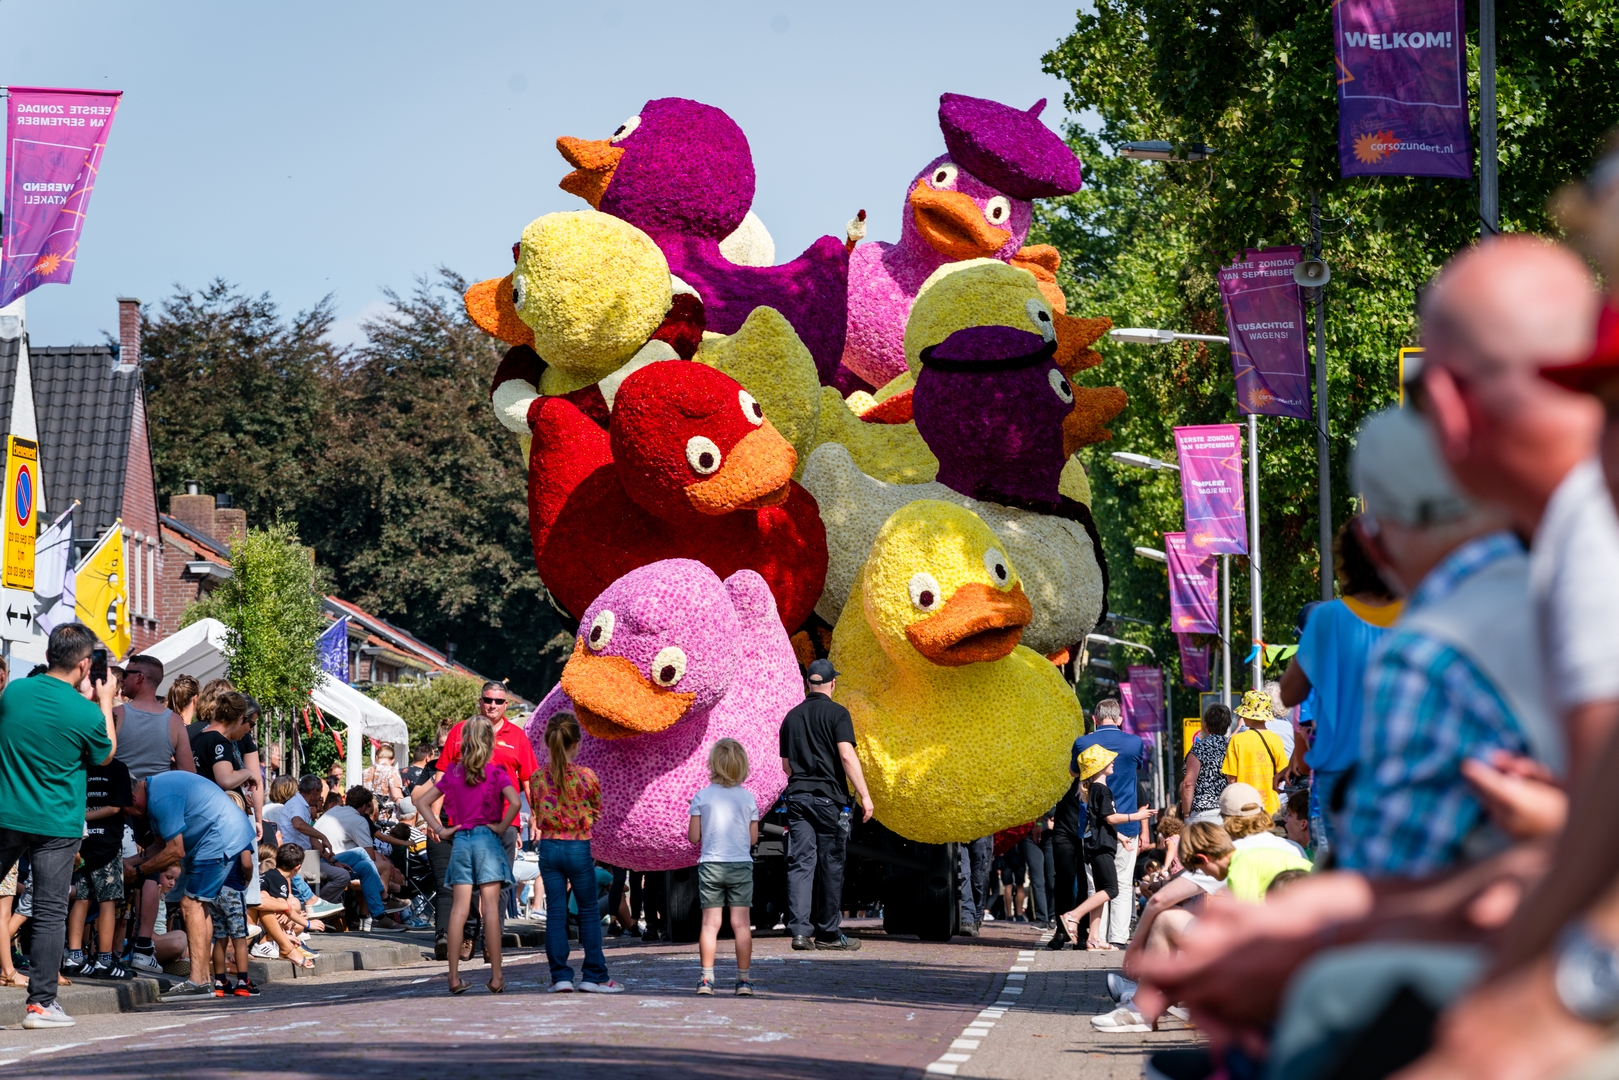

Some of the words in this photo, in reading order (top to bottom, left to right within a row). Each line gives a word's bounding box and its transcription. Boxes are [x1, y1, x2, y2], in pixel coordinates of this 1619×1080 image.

[1344, 31, 1452, 50] WELKOM!
[1370, 141, 1454, 154] corsozundert.nl
[1258, 258, 1295, 268] ZONDAG
[1222, 272, 1239, 281] VAN
[1237, 321, 1294, 331] EUSACHTIGE
[1249, 331, 1289, 340] WAGENS!
[1206, 434, 1235, 442] ZONDAG
